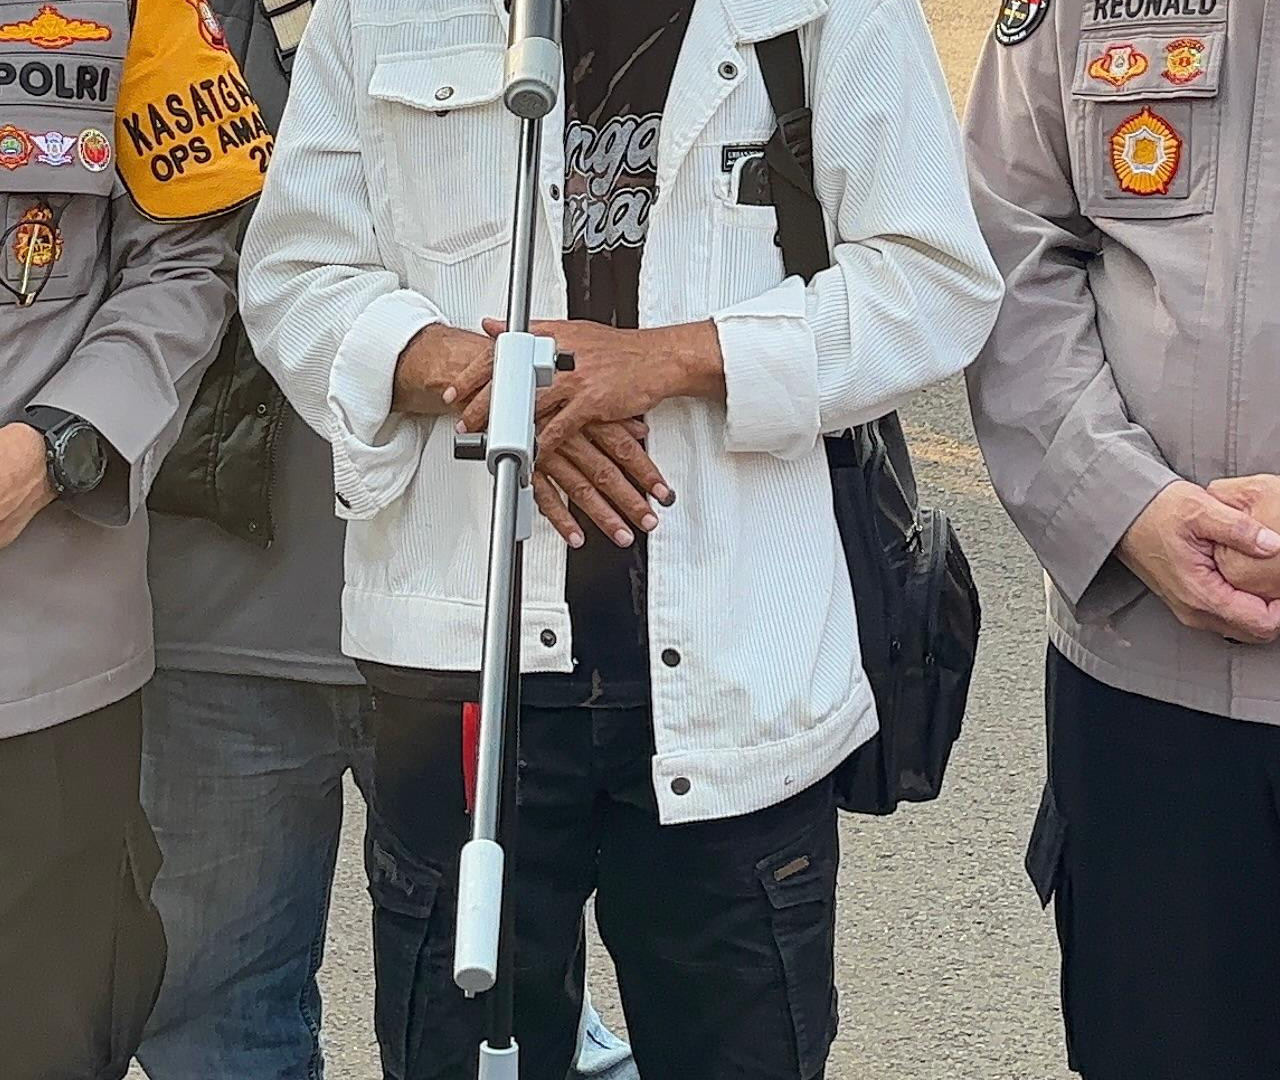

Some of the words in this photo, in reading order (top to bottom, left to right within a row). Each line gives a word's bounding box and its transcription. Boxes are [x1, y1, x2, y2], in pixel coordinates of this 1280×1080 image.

[122, 68, 257, 157] KASATGA
[150, 135, 212, 182] OPS
[217, 110, 271, 154] AMA
